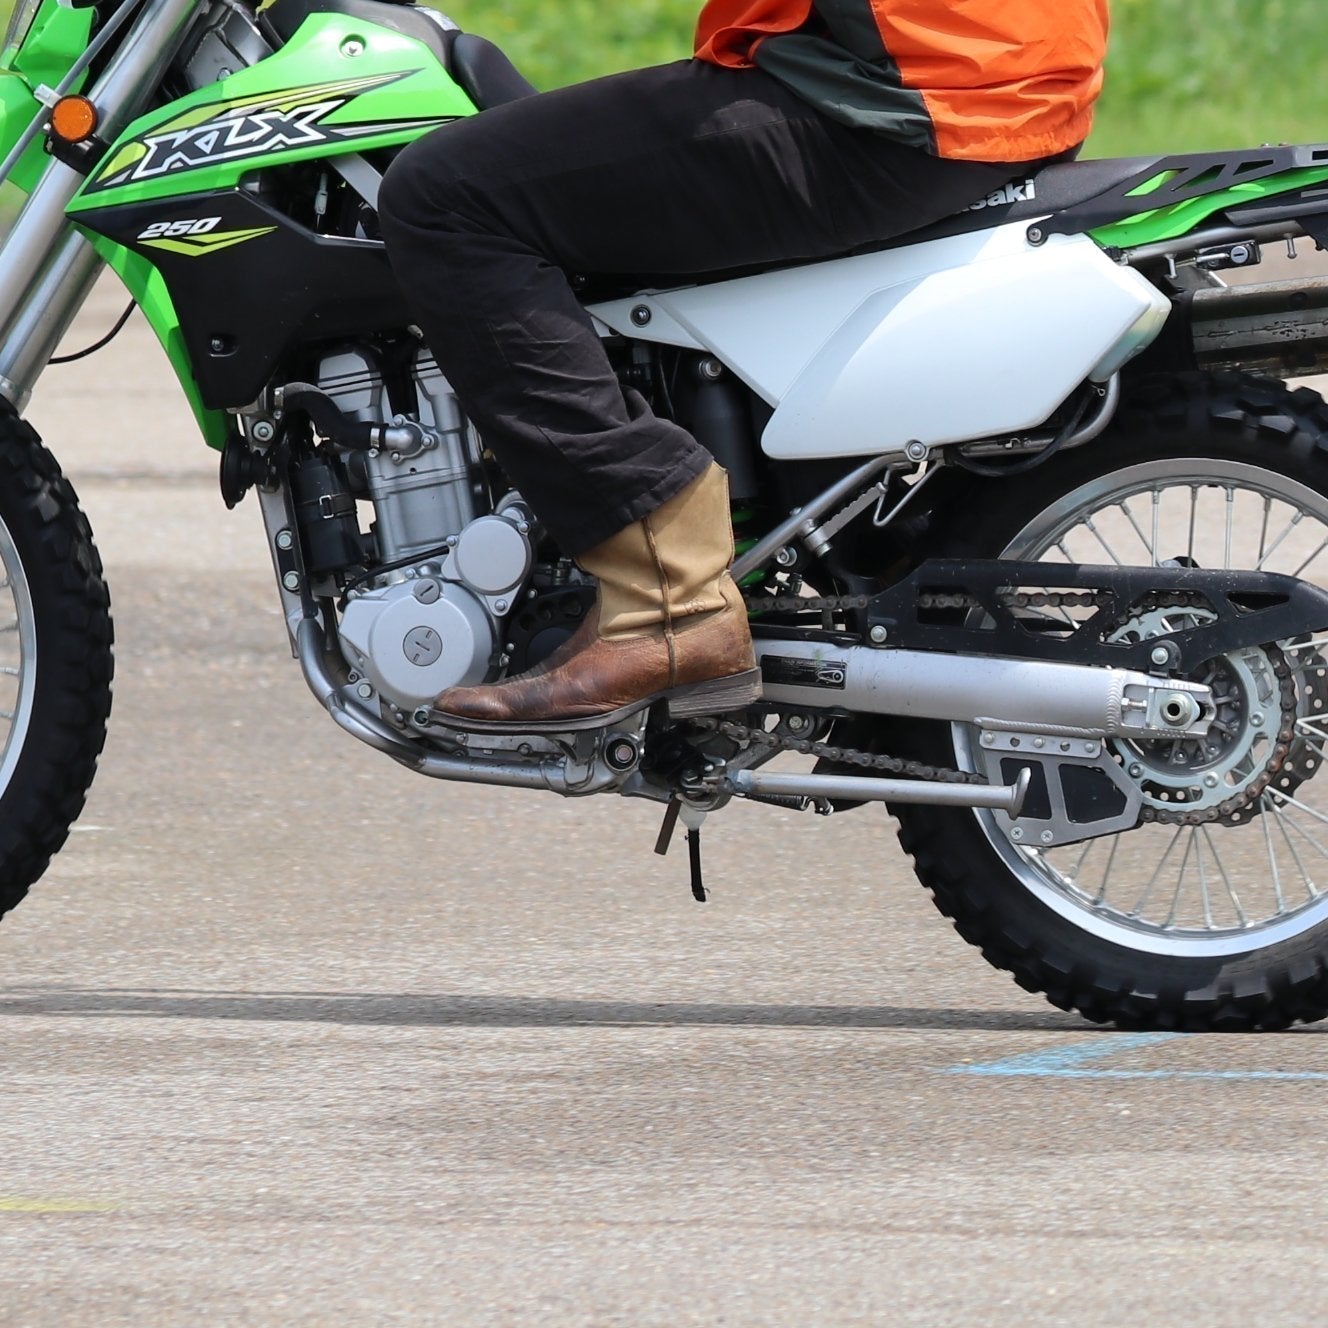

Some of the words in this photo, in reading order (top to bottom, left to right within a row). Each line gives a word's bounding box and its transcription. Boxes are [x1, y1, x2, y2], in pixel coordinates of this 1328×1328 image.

[131, 99, 345, 180] KLX
[962, 178, 1036, 211] saki
[137, 217, 222, 239] 250
